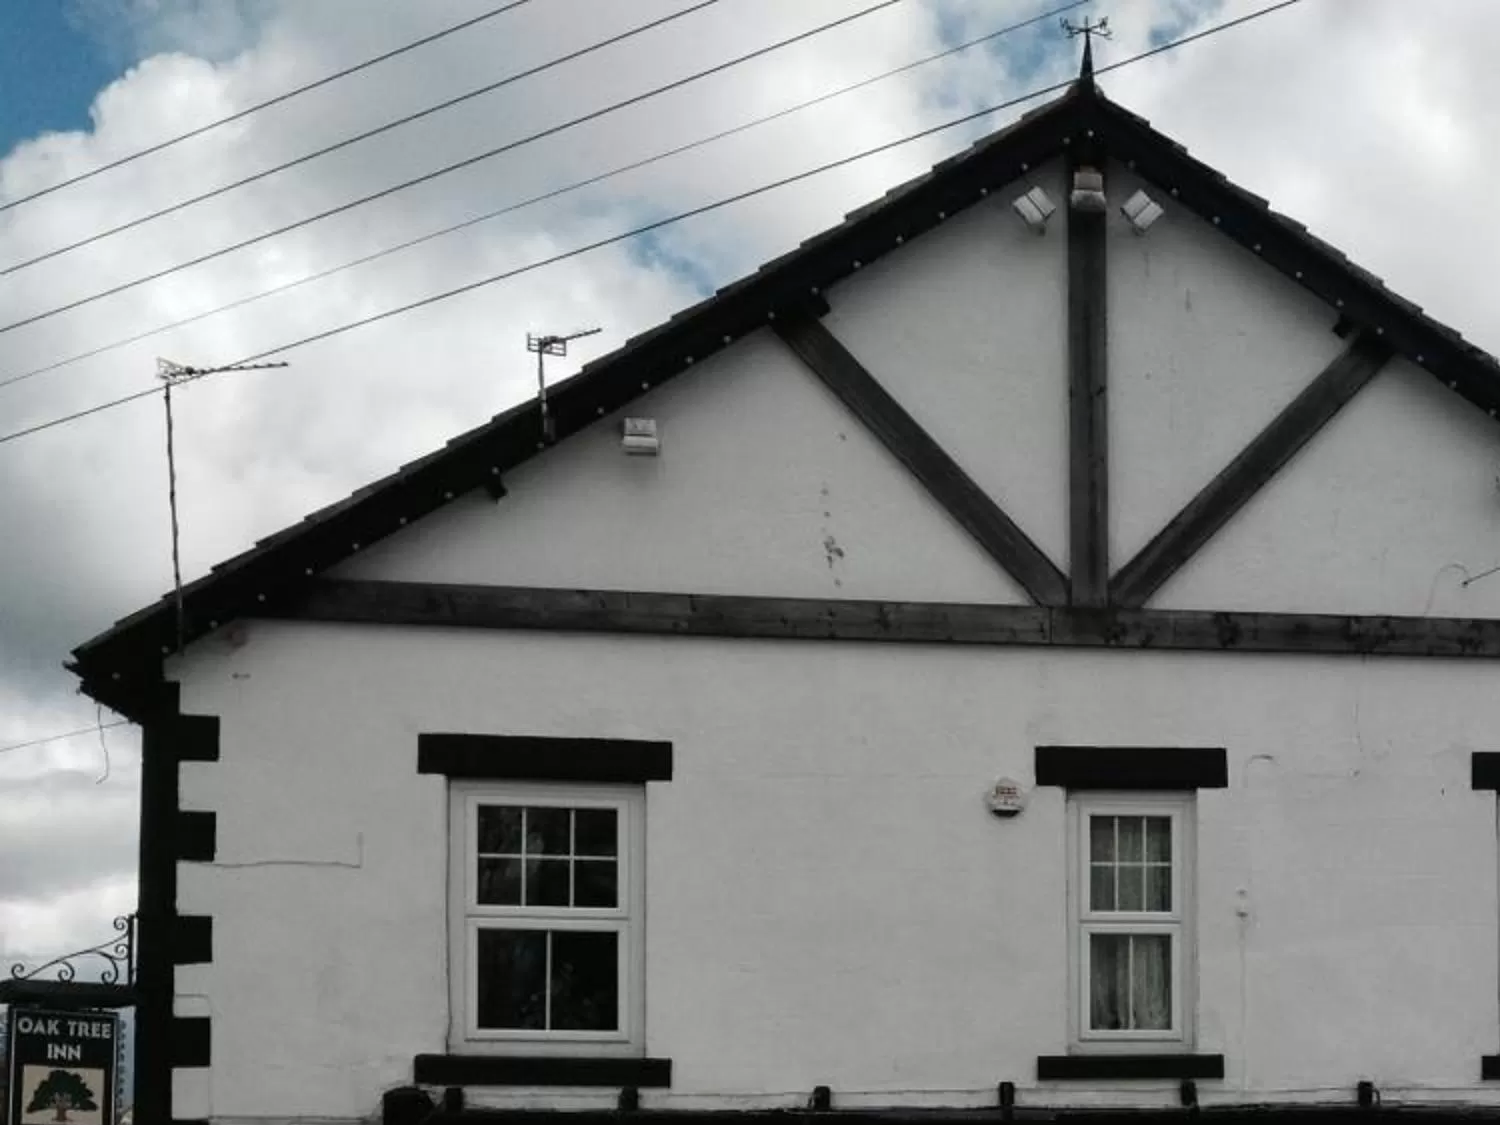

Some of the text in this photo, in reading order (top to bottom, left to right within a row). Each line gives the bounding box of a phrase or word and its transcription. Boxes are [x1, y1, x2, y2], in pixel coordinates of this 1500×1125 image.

[18, 1017, 112, 1039] OAK TREE
[47, 1043, 81, 1061] INN
